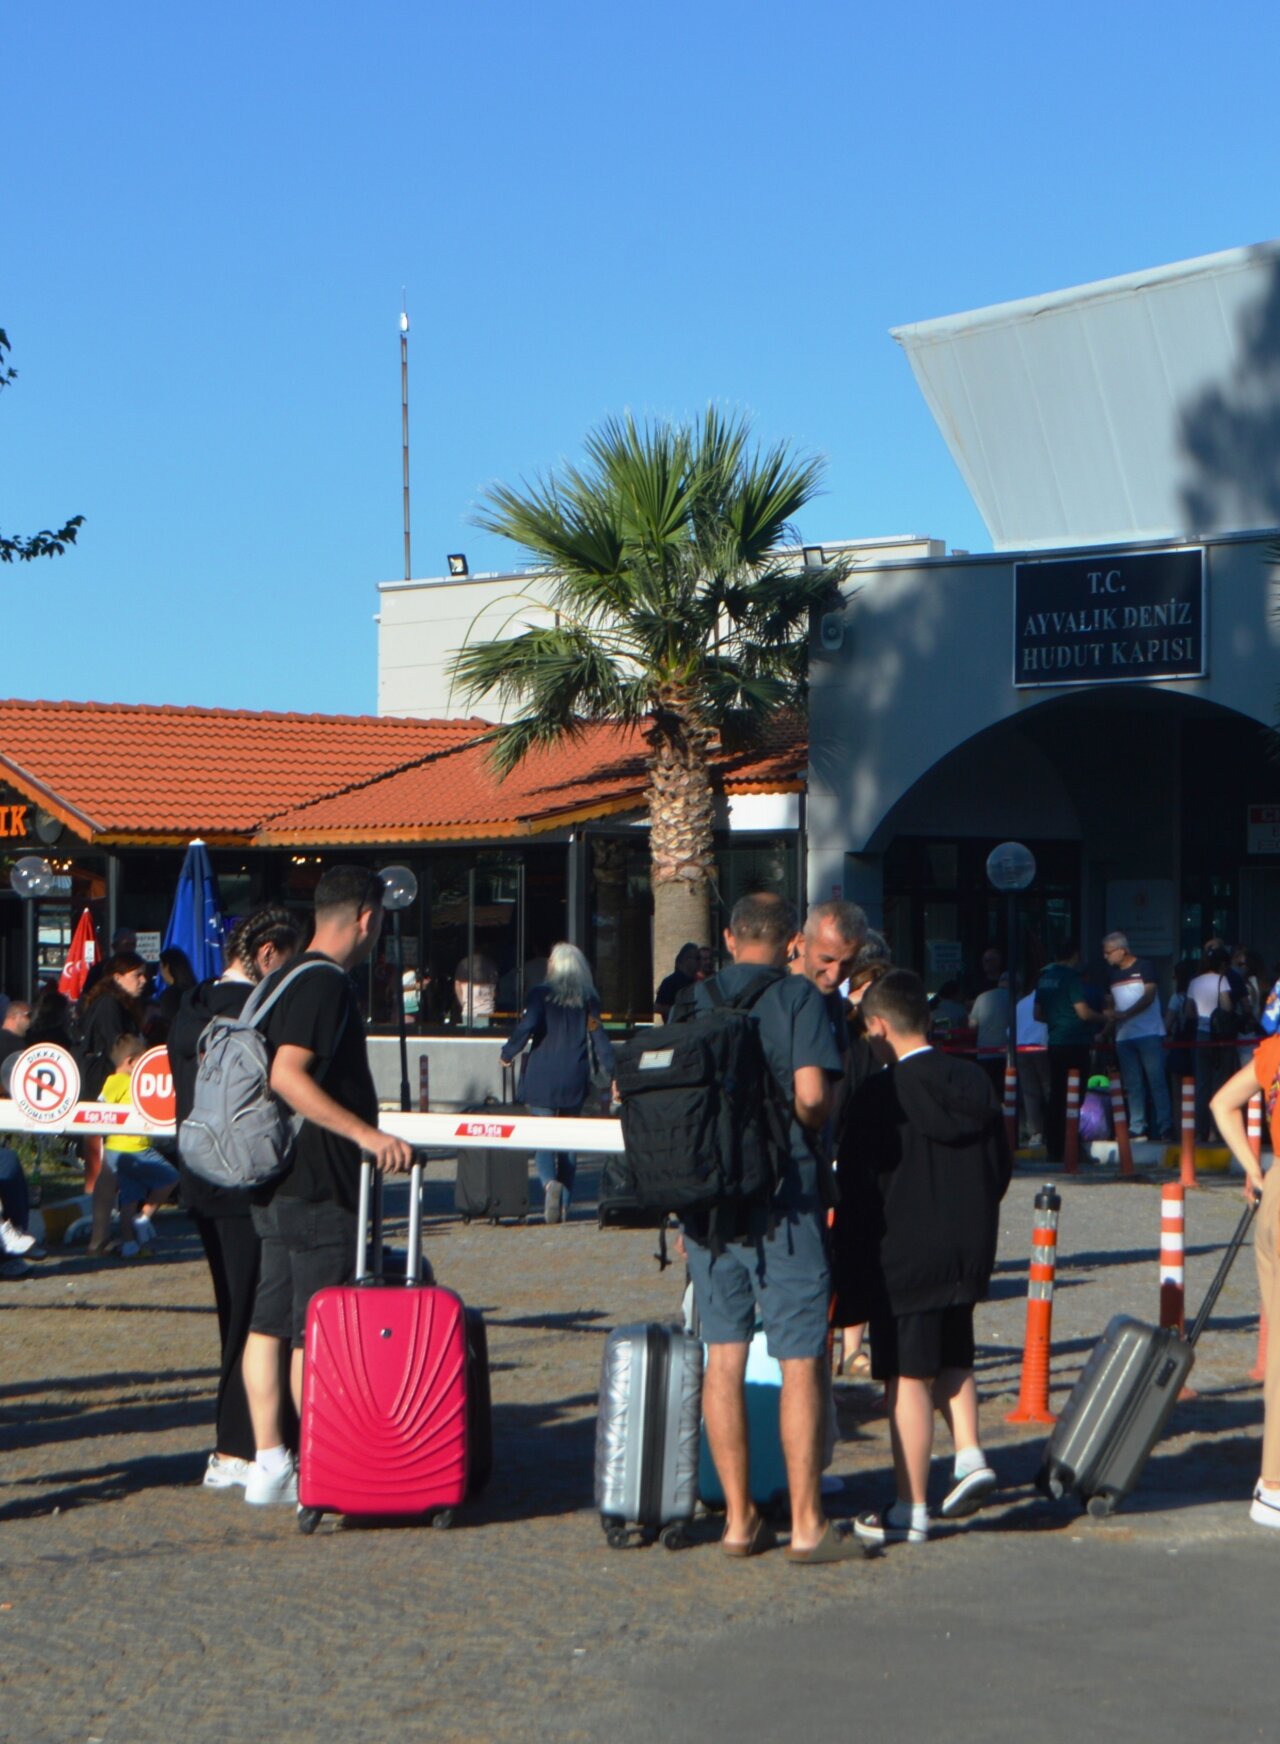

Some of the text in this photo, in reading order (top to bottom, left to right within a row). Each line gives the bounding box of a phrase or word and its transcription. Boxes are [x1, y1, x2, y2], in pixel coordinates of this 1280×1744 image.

[1087, 570, 1126, 594] T.C.
[1024, 597, 1192, 636] AYVALIK DENİZ
[1022, 637, 1194, 671] HUDUT KAPISI
[139, 1072, 176, 1098] DU
